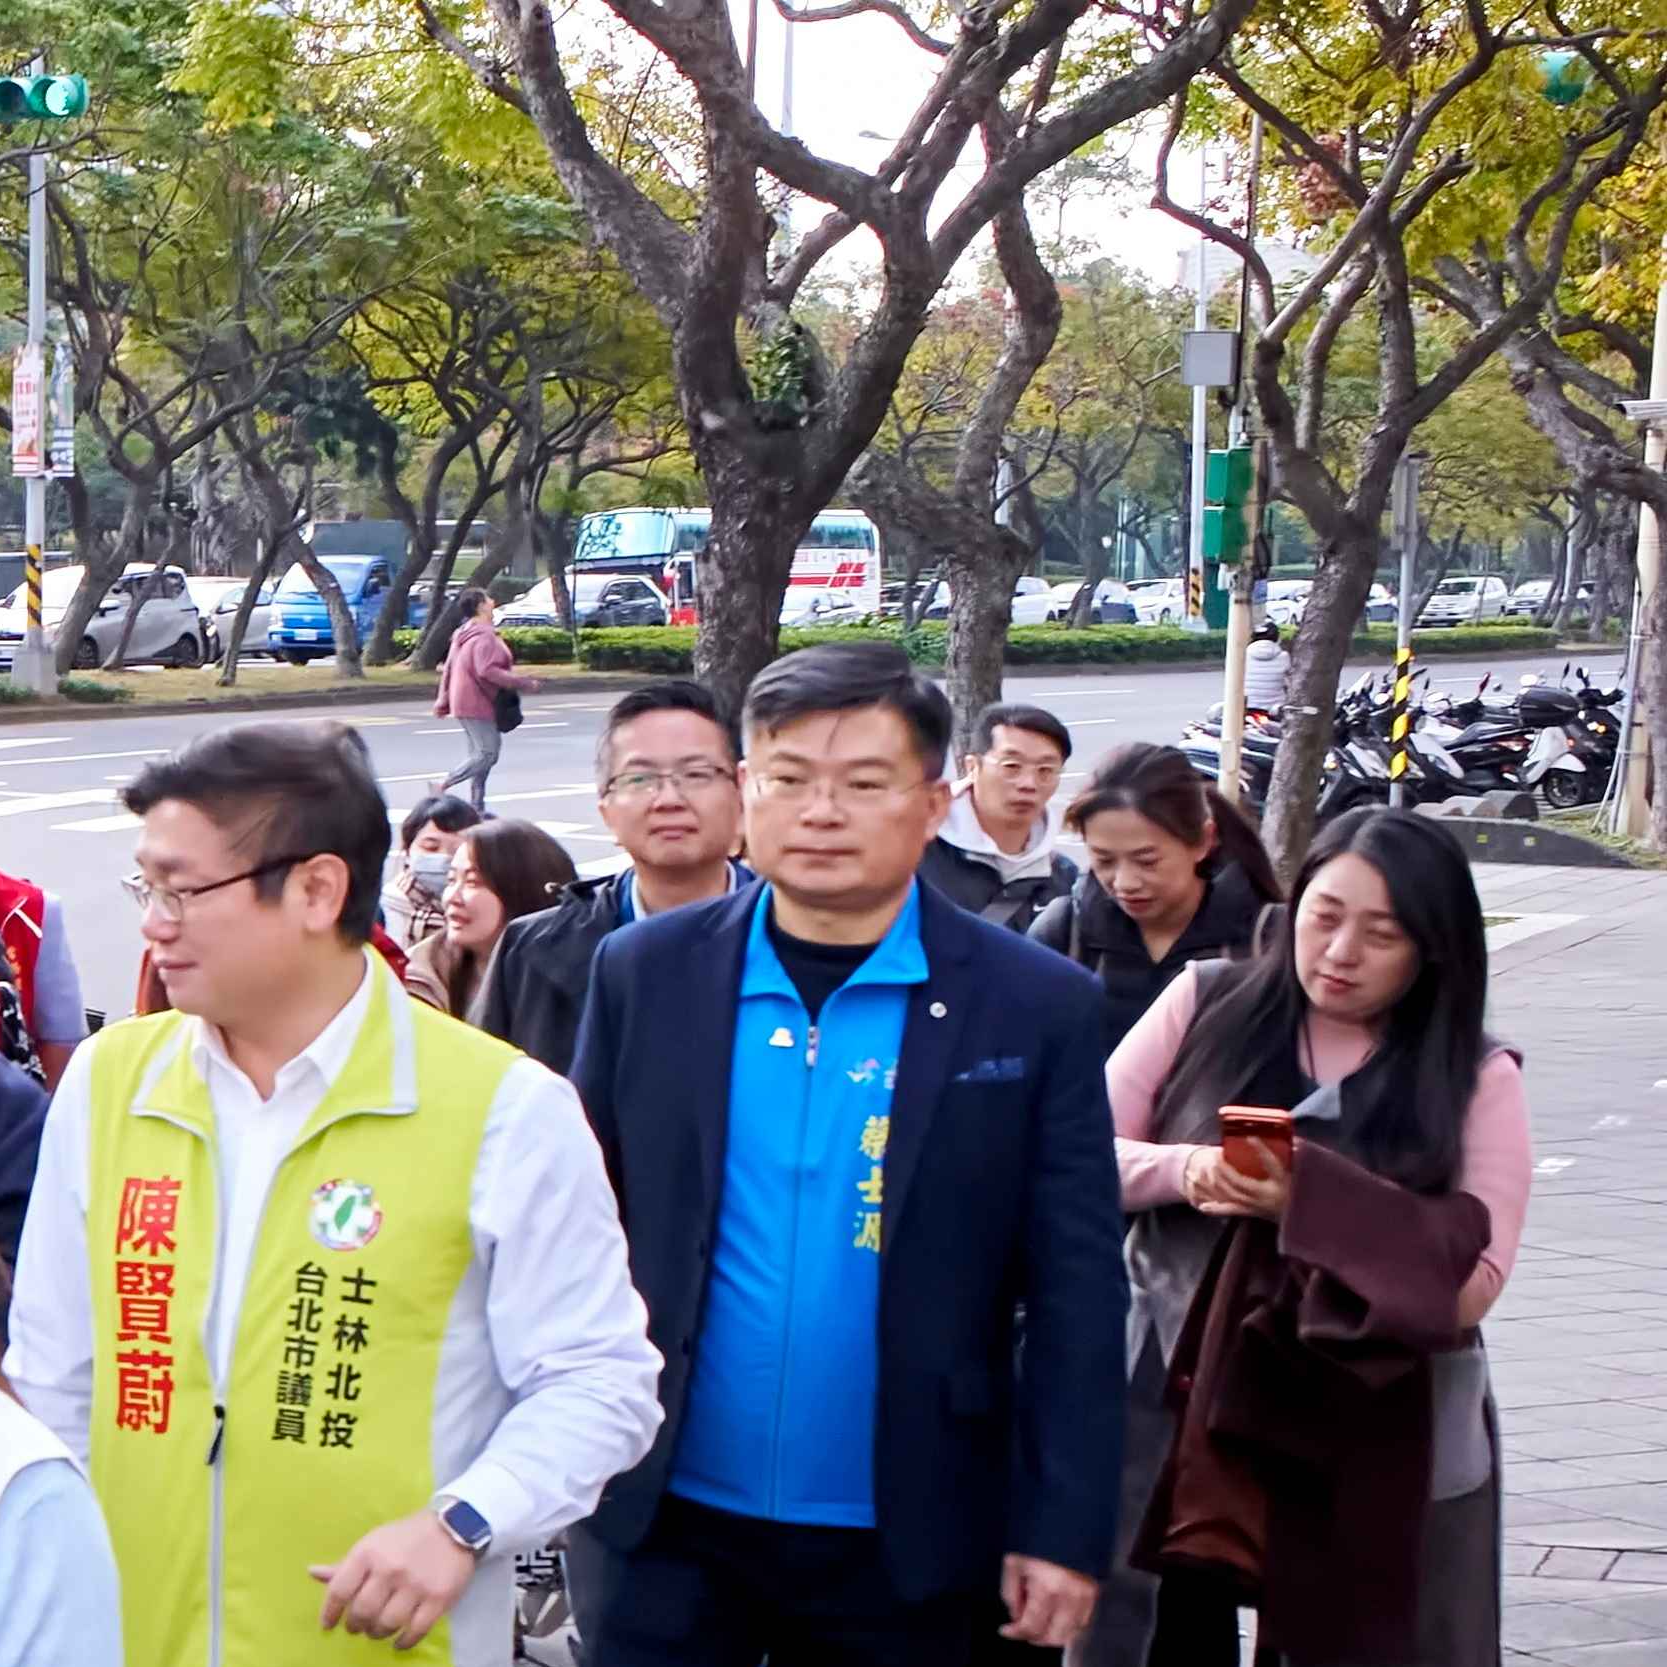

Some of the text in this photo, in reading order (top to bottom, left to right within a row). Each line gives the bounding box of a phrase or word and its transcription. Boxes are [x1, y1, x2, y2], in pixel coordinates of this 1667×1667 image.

[116, 1175, 183, 1434] 陳賢蔚
[271, 1260, 329, 1445] 台北市議員
[319, 1266, 378, 1450] 士林北投
